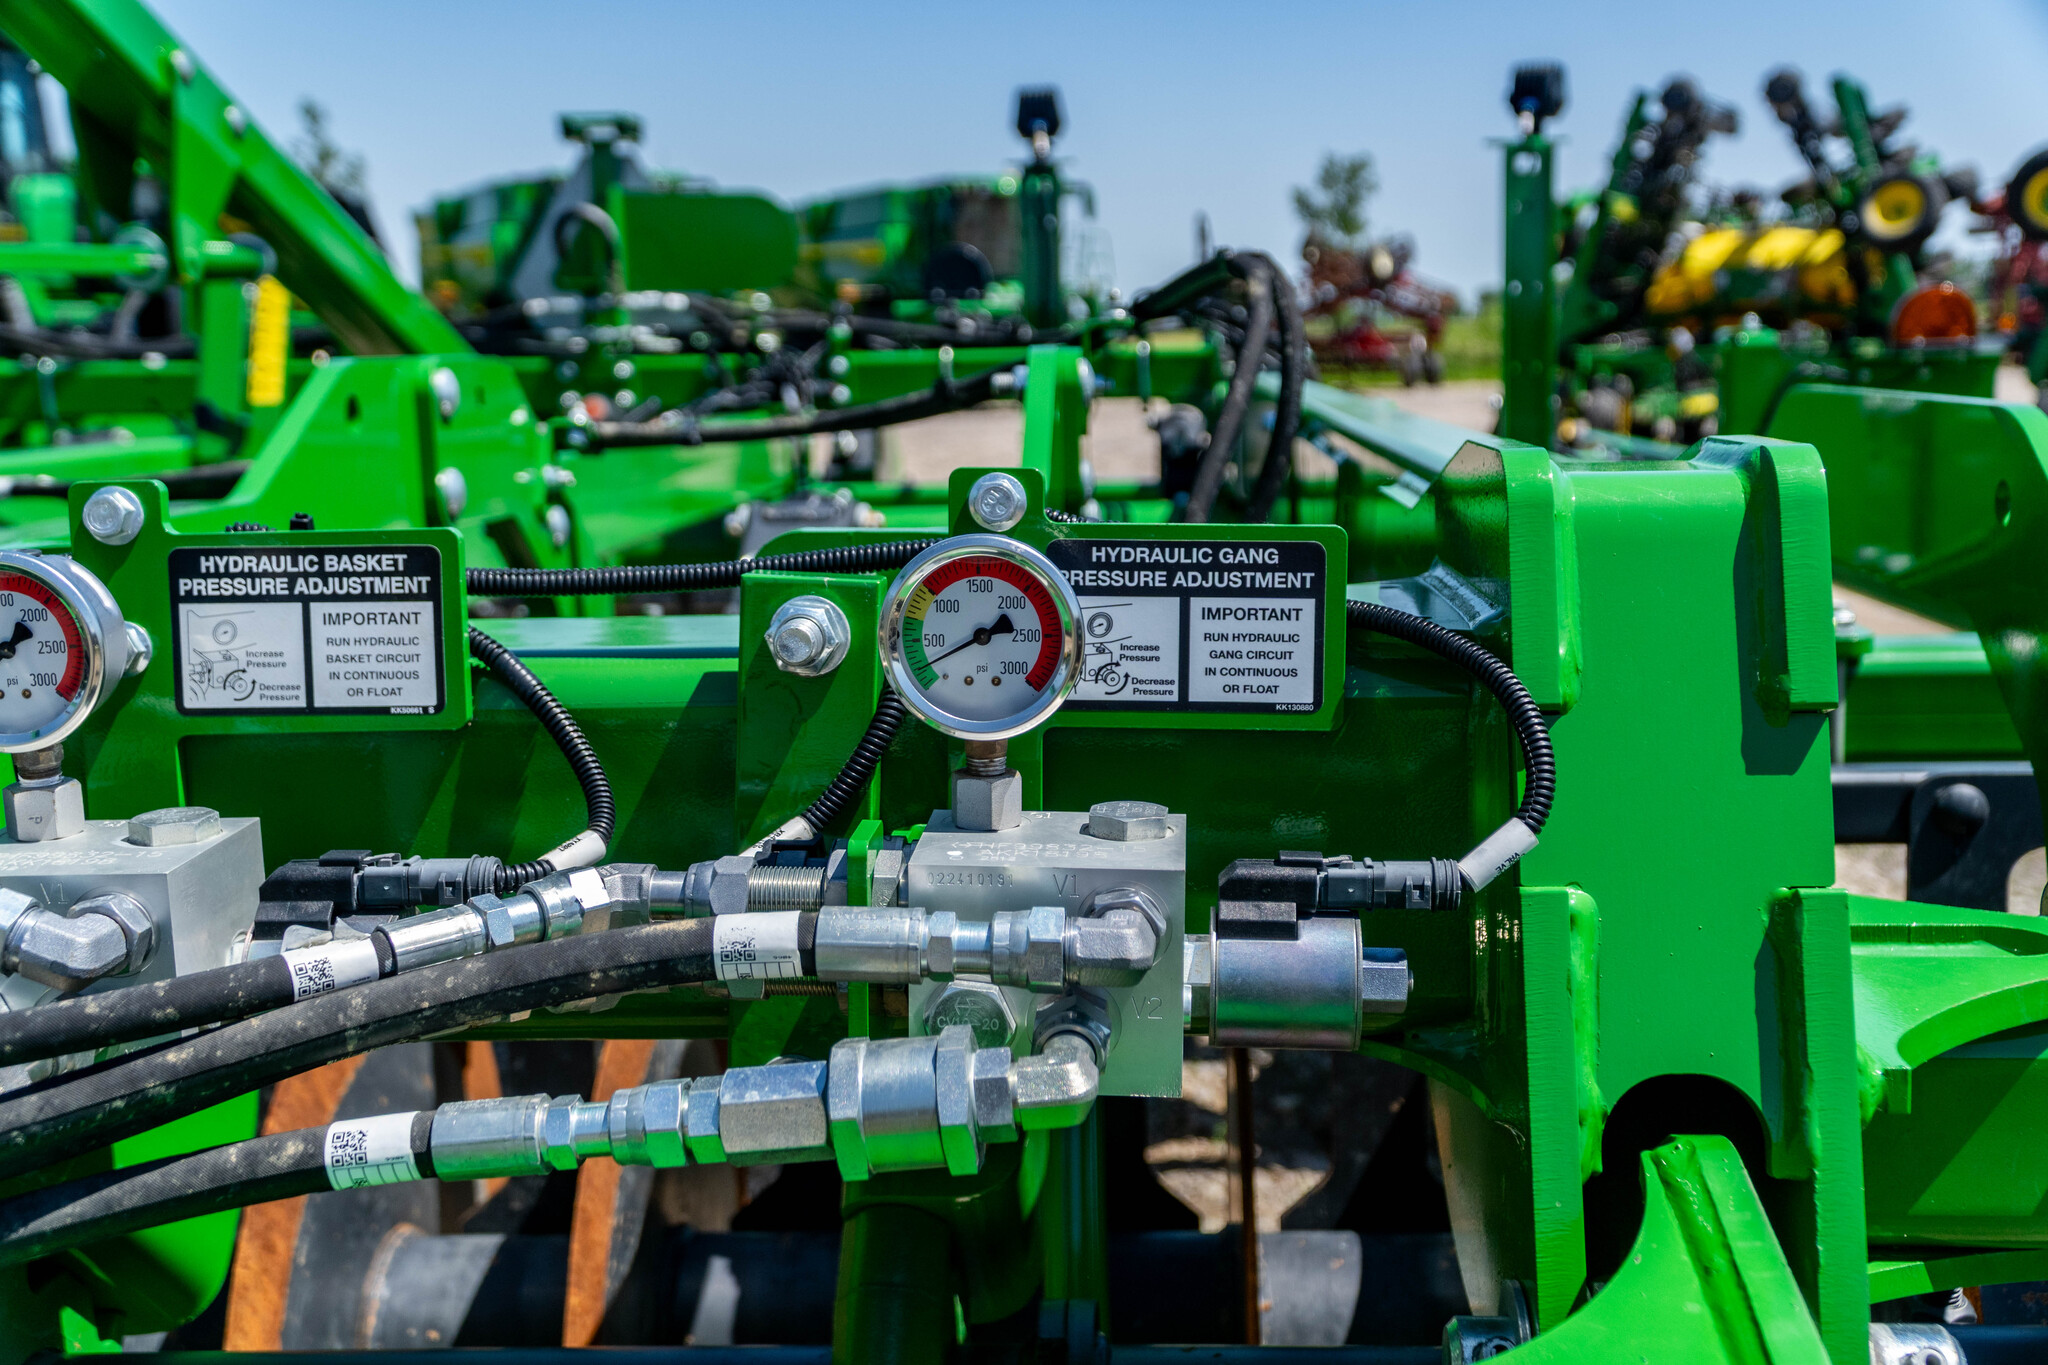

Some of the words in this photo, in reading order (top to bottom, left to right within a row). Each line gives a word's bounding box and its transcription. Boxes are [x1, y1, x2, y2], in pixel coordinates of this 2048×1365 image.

[1091, 546, 1213, 564] HYDRAULIC
[1219, 548, 1280, 565] GANG
[200, 555, 319, 574] HYDRAULIC
[324, 554, 408, 572] BASKET
[179, 578, 290, 597] PRESSURE
[293, 576, 431, 596] ADJUSTMENT
[966, 579, 993, 593] 1500
[1172, 571, 1315, 589] ADJUSTMENT
[933, 599, 960, 613] 1000
[997, 595, 1026, 610] 2000
[19, 608, 48, 622] 2000
[322, 612, 422, 626] IMPORTANT
[1201, 607, 1303, 621] IMPORTANT
[326, 637, 352, 647] RUN
[353, 636, 420, 646] HYDRAULIC
[923, 633, 945, 648] 500
[1012, 629, 1041, 643] 2500
[1203, 632, 1230, 642] RUN
[1232, 633, 1301, 643] HYDRAULIC
[38, 640, 66, 655] 2500
[1119, 643, 1160, 651] Increase
[245, 650, 285, 658] Increase
[326, 654, 373, 664] BASKET
[375, 653, 421, 663] CIRCUIT
[1119, 654, 1161, 662] Pressure
[1209, 650, 1244, 660] GANG
[1246, 651, 1294, 660] CIRCUIT
[246, 660, 287, 668] Pressure
[976, 662, 989, 675] psi
[1000, 661, 1028, 675] 3000
[329, 671, 341, 681] IN
[343, 670, 420, 681] CONTINUOUS
[1204, 667, 1217, 677] IN
[1219, 667, 1298, 678] CONTINUOUS
[6, 676, 19, 687] psi
[29, 672, 58, 687] 3000
[1131, 677, 1176, 686] Decrease
[259, 683, 302, 691] Decrease
[347, 688, 365, 697] OR
[367, 687, 403, 697] FLOAT
[1132, 687, 1174, 696] Pressure
[1222, 684, 1240, 694] OR
[1243, 684, 1280, 694] FLOAT
[259, 693, 300, 701] Pressure
[1053, 873, 1080, 898] V1
[1131, 997, 1163, 1020] V2
